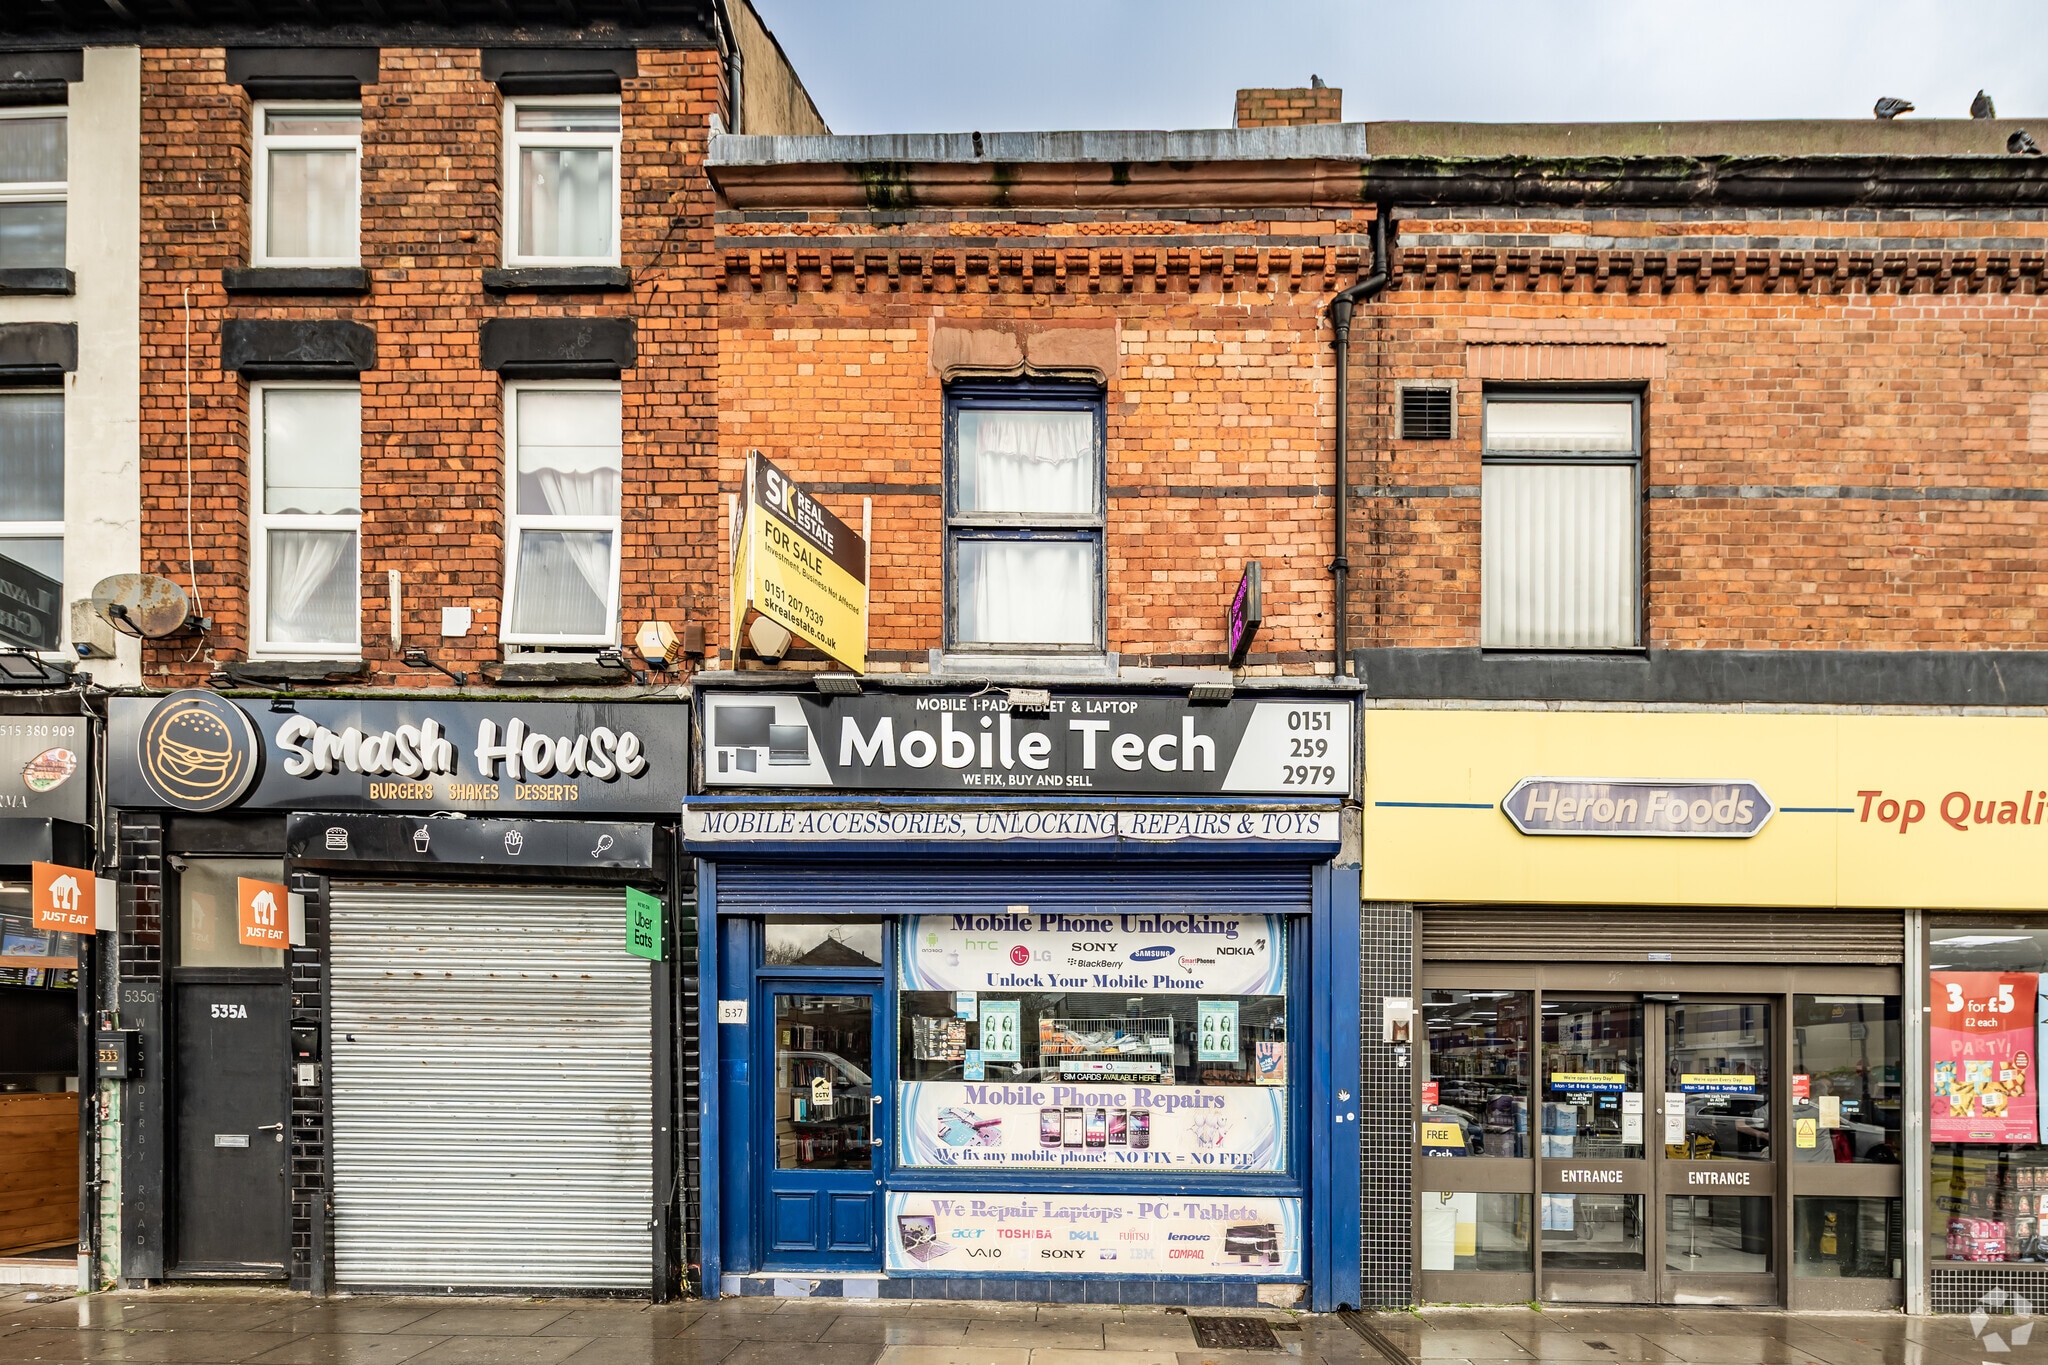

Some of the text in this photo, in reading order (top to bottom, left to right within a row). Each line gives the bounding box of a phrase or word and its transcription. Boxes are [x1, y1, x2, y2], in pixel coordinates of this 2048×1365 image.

[766, 469, 797, 520] SK
[797, 492, 825, 526] REAL
[797, 508, 834, 550] ESTATE
[765, 520, 790, 553] FOR
[793, 541, 823, 576] SALE
[802, 568, 828, 592] Business
[828, 587, 838, 599] Not
[764, 580, 824, 627] 0151 207 9339
[764, 597, 837, 650] skrealestate.co.uk
[916, 698, 967, 711] MOBILE
[1071, 701, 1082, 713] &
[1086, 701, 1138, 714] LAPTOP
[1287, 711, 1332, 731] 0151
[26, 725, 48, 737] 380
[52, 725, 75, 737] 909
[275, 714, 648, 781] Smash House
[839, 711, 1216, 772] Mobile Tech
[1290, 738, 1328, 758] 259
[962, 774, 1092, 788] WE FIX, BUY AND SELL
[1282, 765, 1336, 786] 2979
[369, 783, 579, 801] BURGERS SHAKES DESSERTS
[1524, 788, 1755, 825] Heron Foods
[1856, 790, 2048, 834] Top Quali
[700, 812, 796, 834] MOBILE
[798, 812, 968, 837] ACCESSORIES,
[1130, 813, 1232, 834] REPAIRS
[1236, 813, 1255, 834] &
[1261, 812, 1322, 834] TOYS
[41, 910, 89, 925] JUST EAT
[634, 909, 653, 931] Uber
[245, 926, 284, 940] JUST EAT
[950, 914, 1240, 940] Mobile Phone Unlocking
[634, 928, 653, 949] Eats
[1071, 942, 1118, 952] SONY
[1134, 950, 1171, 958] SAMSUNG
[1216, 947, 1255, 956] NOKIA
[1033, 950, 1052, 962] LG
[1077, 959, 1124, 970] BlackBerry
[987, 973, 1204, 989] Unlock Your Mobile Phone
[124, 989, 156, 1003] 535a
[1945, 983, 2015, 1013] 3 for £5
[210, 1003, 248, 1019] 535A
[724, 1008, 743, 1018] 537
[1965, 1017, 1998, 1027] £2 each
[98, 1050, 119, 1061] 533
[1063, 1073, 1157, 1082] SIM CARDS AVAILABLE HERE
[963, 1085, 1225, 1114] Mobile Phone Repairs
[1426, 1130, 1449, 1140] FREE
[936, 1148, 959, 1161] We
[962, 1149, 982, 1161] fix
[983, 1151, 1008, 1164] any
[1011, 1150, 1058, 1162] mobile
[1060, 1150, 1107, 1165] phone!
[1114, 1151, 1139, 1164] NO
[1143, 1152, 1172, 1164] FIX
[1190, 1152, 1215, 1165] NO
[1219, 1152, 1256, 1165] FEE
[1561, 1169, 1623, 1184] ENTRANCE
[1688, 1171, 1751, 1186] ENTRANCE
[931, 1199, 1258, 1224] We Repair Laptops PC Tablets
[951, 1228, 985, 1239] acer
[996, 1228, 1053, 1239] TOSHIBA
[1069, 1230, 1099, 1241] DELL
[1119, 1231, 1150, 1241] FUJITSU
[1167, 1232, 1211, 1241] lenovo
[1041, 1249, 1086, 1259] SONY
[1168, 1249, 1205, 1260] COMPAQ
